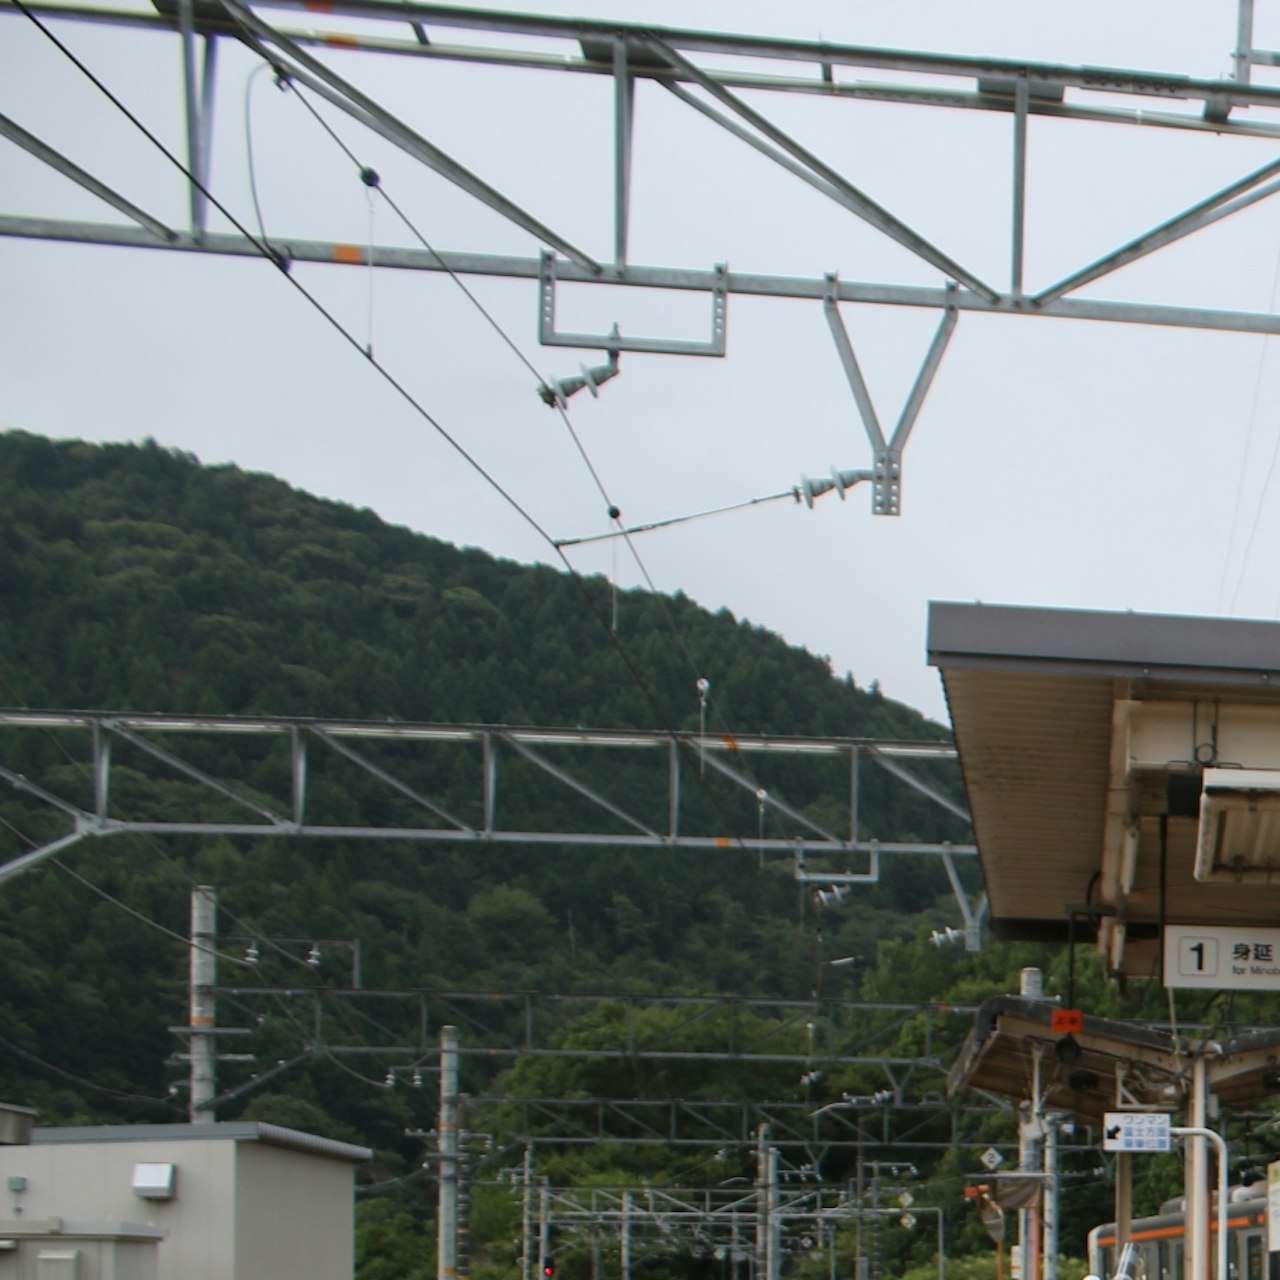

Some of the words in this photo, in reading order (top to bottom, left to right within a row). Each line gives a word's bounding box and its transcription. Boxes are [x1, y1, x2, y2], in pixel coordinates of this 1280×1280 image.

[1189, 941, 1204, 971] 1
[1232, 966, 1246, 975] for
[1123, 1115, 1166, 1125] ワンマン
[1124, 1126, 1167, 1137] 富士方面
[987, 1152, 996, 1164] 2
